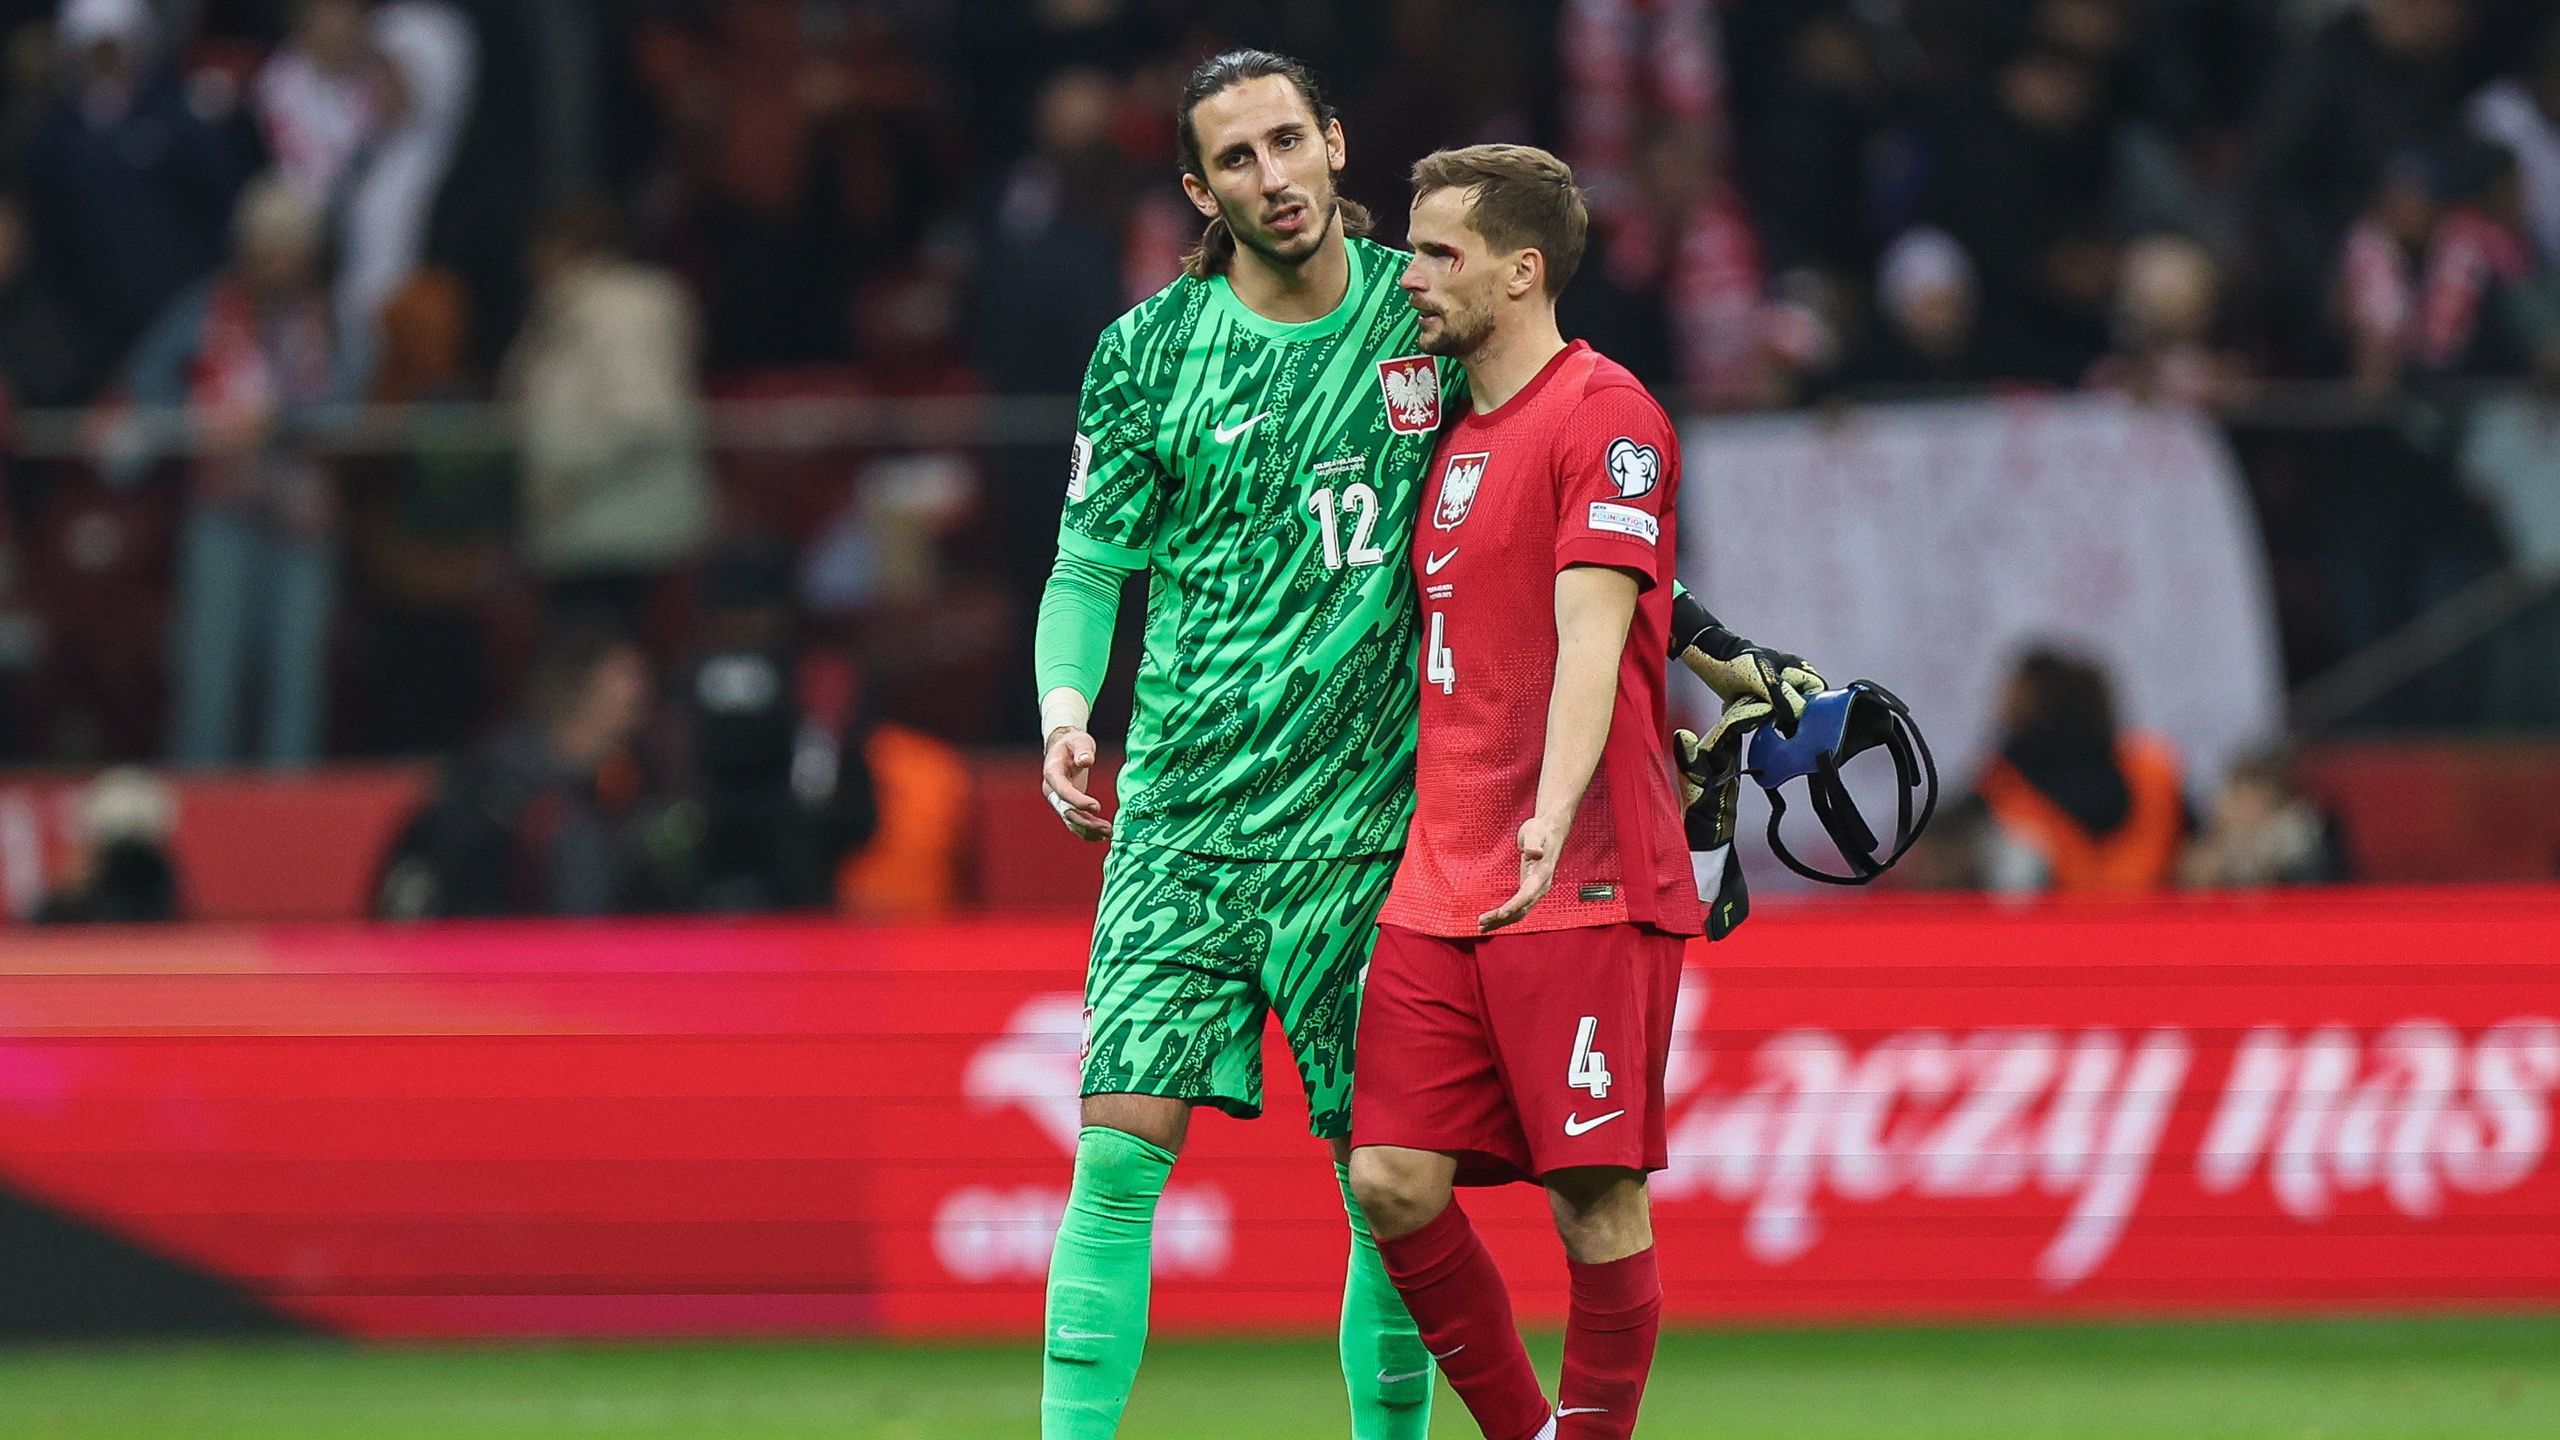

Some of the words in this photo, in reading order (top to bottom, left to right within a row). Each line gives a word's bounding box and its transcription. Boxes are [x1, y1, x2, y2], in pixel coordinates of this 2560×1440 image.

[1308, 483, 1383, 570] 12
[1427, 611, 1456, 695] 4
[1567, 1016, 1611, 1098] 4
[2195, 1017, 2560, 1223] nas
